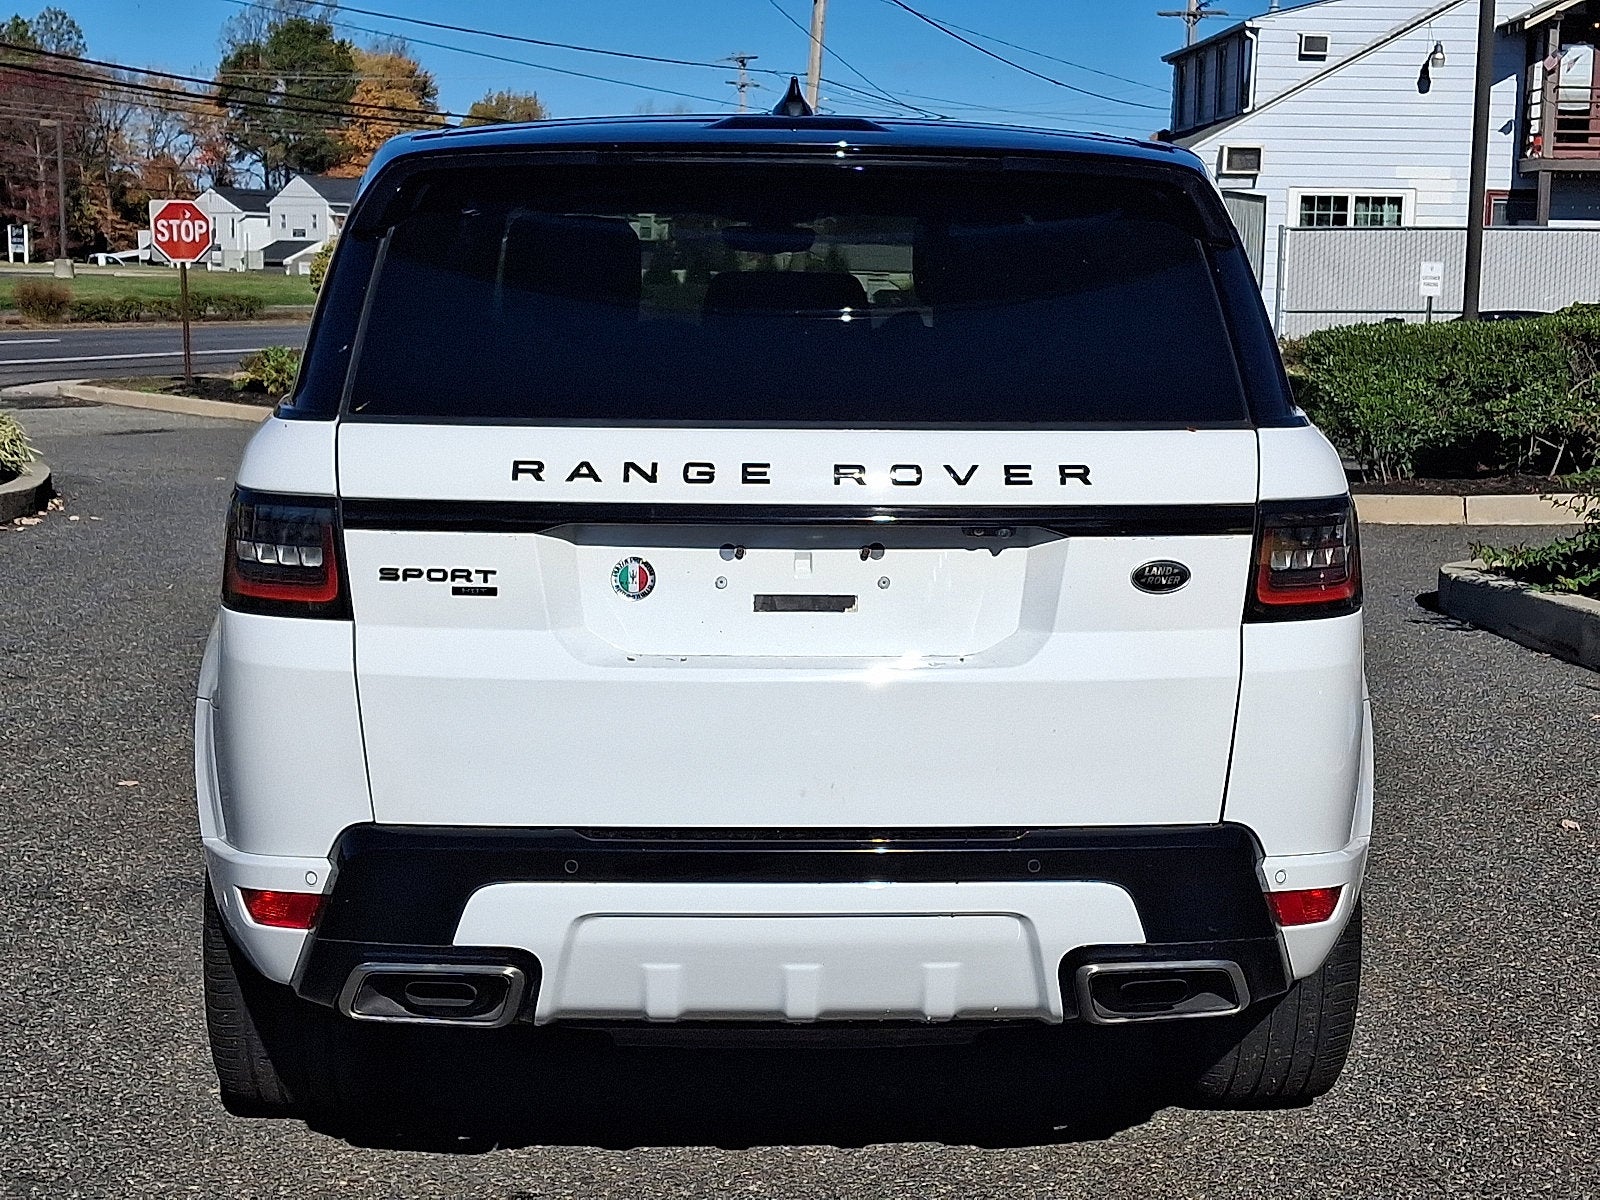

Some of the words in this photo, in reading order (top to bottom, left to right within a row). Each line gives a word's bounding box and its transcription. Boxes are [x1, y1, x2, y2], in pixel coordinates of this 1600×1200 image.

[156, 219, 207, 243] STOP
[511, 460, 771, 484] RANGE
[833, 464, 1092, 486] ROVER
[379, 567, 497, 583] SPORT
[1144, 566, 1172, 576] LAND
[1146, 575, 1180, 585] ROVER
